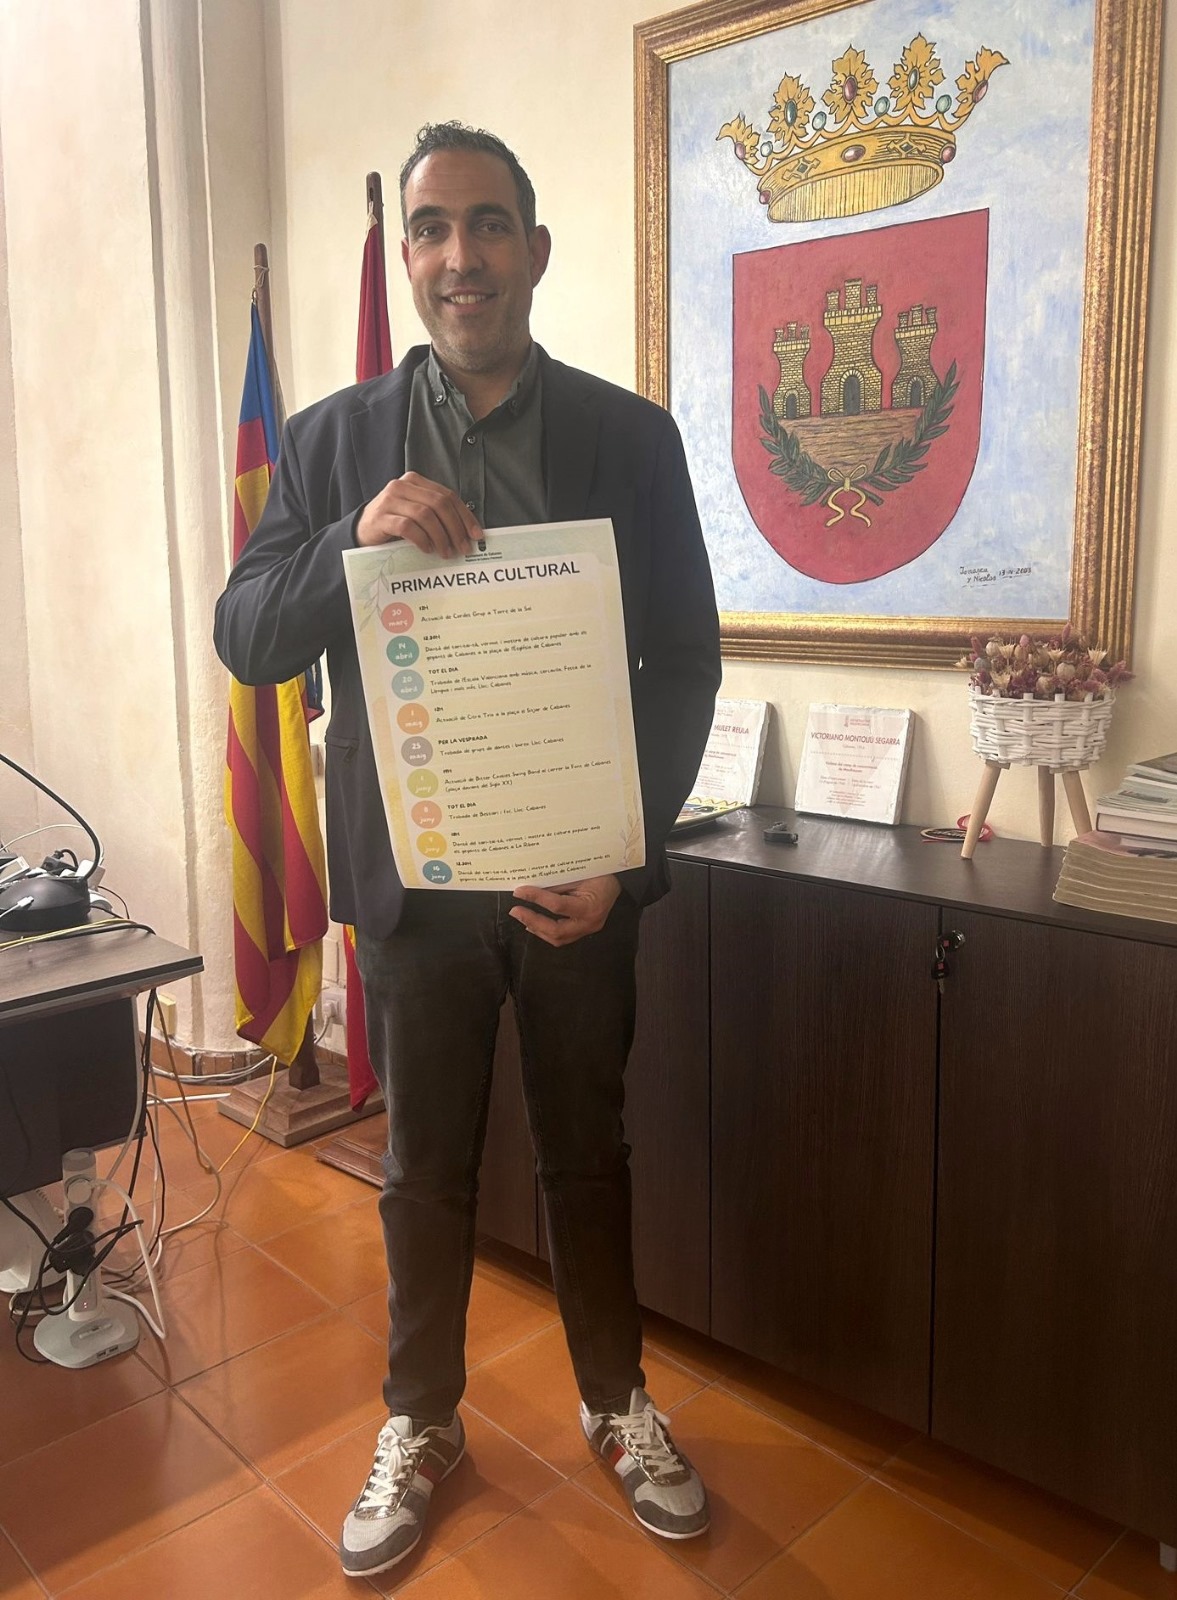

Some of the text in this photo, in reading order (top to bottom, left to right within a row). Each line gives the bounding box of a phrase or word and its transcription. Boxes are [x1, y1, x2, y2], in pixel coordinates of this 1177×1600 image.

[391, 562, 580, 594] PRIMAVERA CULTURAL
[811, 732, 844, 741] VICTORIANO
